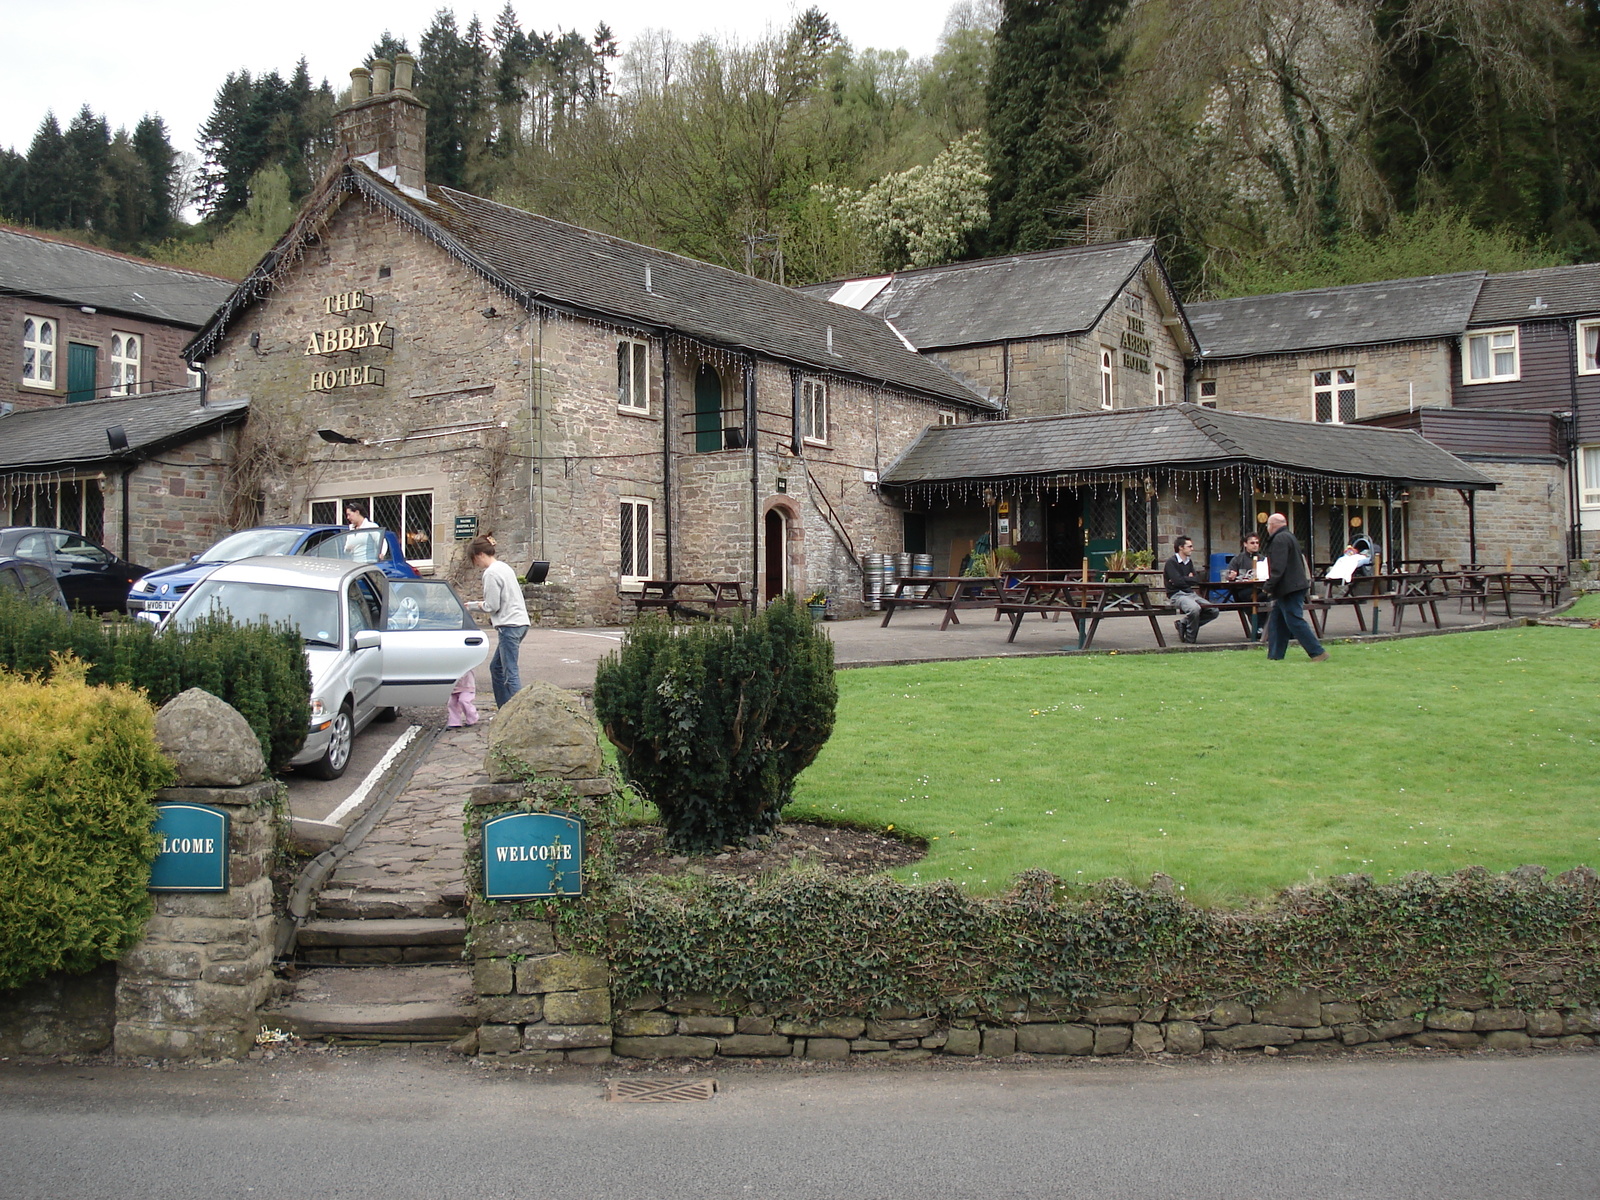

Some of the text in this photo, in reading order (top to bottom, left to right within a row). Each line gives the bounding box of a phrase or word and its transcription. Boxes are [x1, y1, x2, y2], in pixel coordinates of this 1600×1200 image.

[322, 289, 365, 315] THE
[1126, 315, 1145, 335] THE
[304, 320, 388, 356] ABBEY
[1120, 330, 1152, 358] ABBEY
[1123, 353, 1151, 375] HOTEL
[310, 364, 377, 391] HOTEL
[161, 838, 214, 854] LCOME
[496, 844, 572, 862] WELCOME
